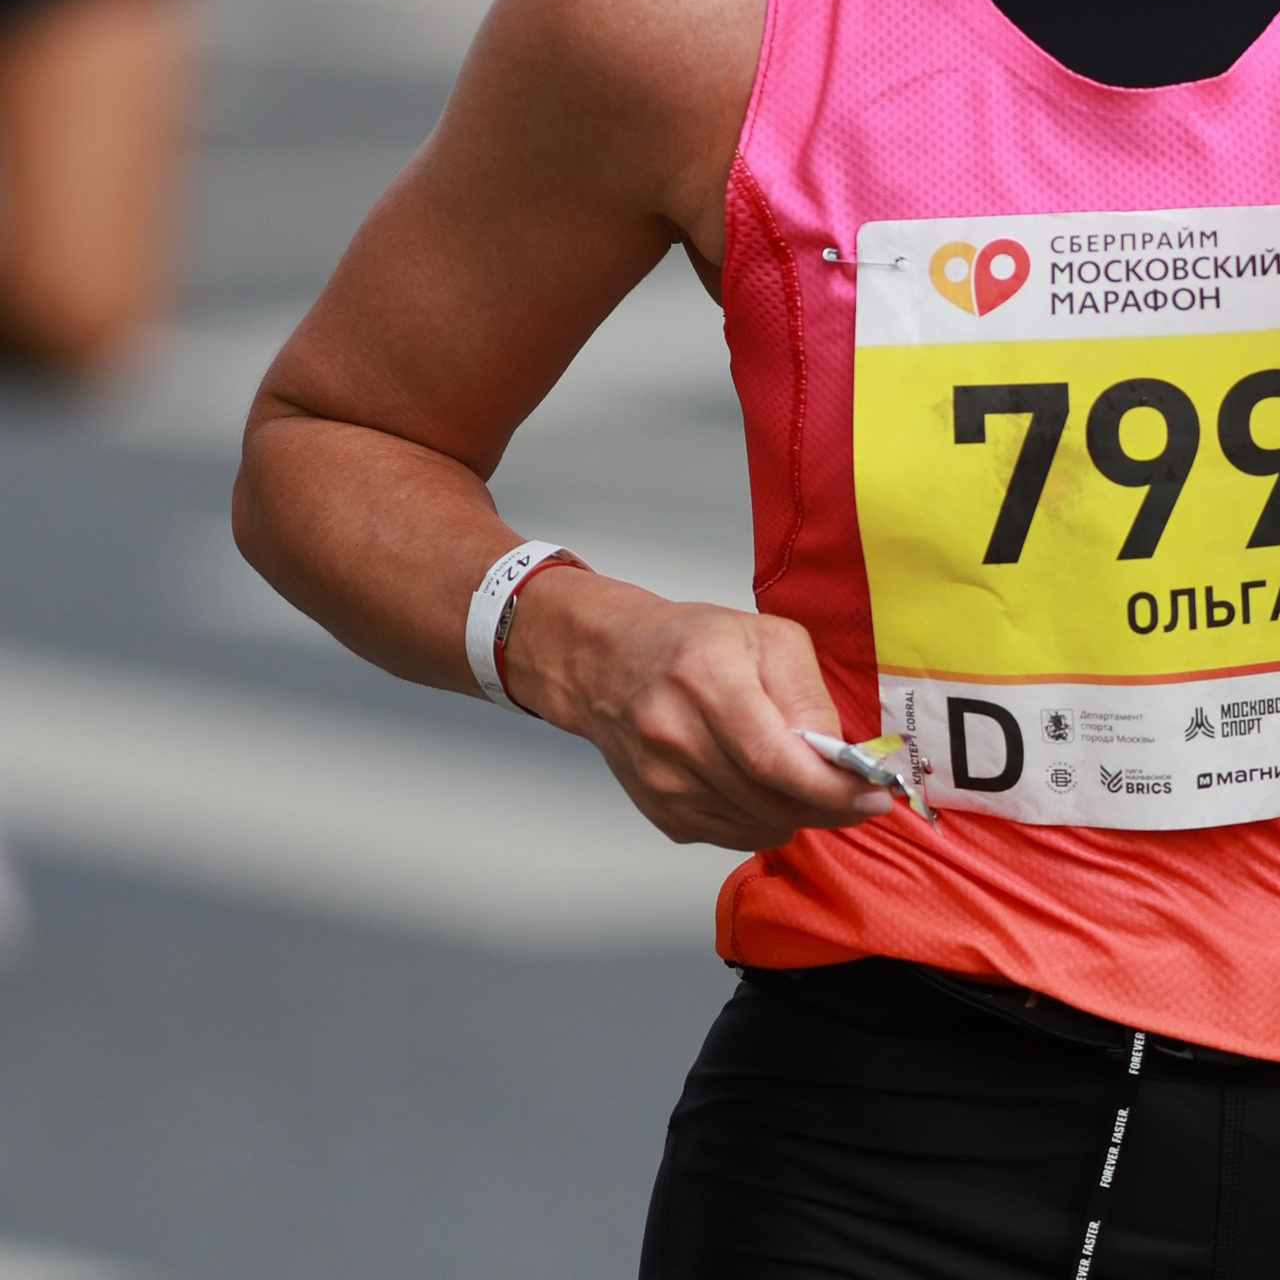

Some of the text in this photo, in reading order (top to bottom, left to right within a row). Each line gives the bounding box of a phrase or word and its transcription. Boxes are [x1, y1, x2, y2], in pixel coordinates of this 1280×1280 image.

[1050, 226, 1219, 254] СБЕРПРАЙМ
[1050, 286, 1221, 315] МАРАФОН
[491, 555, 530, 596] 42,
[904, 689, 915, 731] CORRAL
[1080, 723, 1113, 732] спорта
[1221, 717, 1262, 738] СПОРТ
[947, 696, 1024, 793] D
[1126, 782, 1172, 794] BRICS
[1128, 1032, 1146, 1075] FOREVER
[1099, 1107, 1130, 1188] FOREVER. FASTER.
[1082, 1220, 1101, 1256] FASTER.
